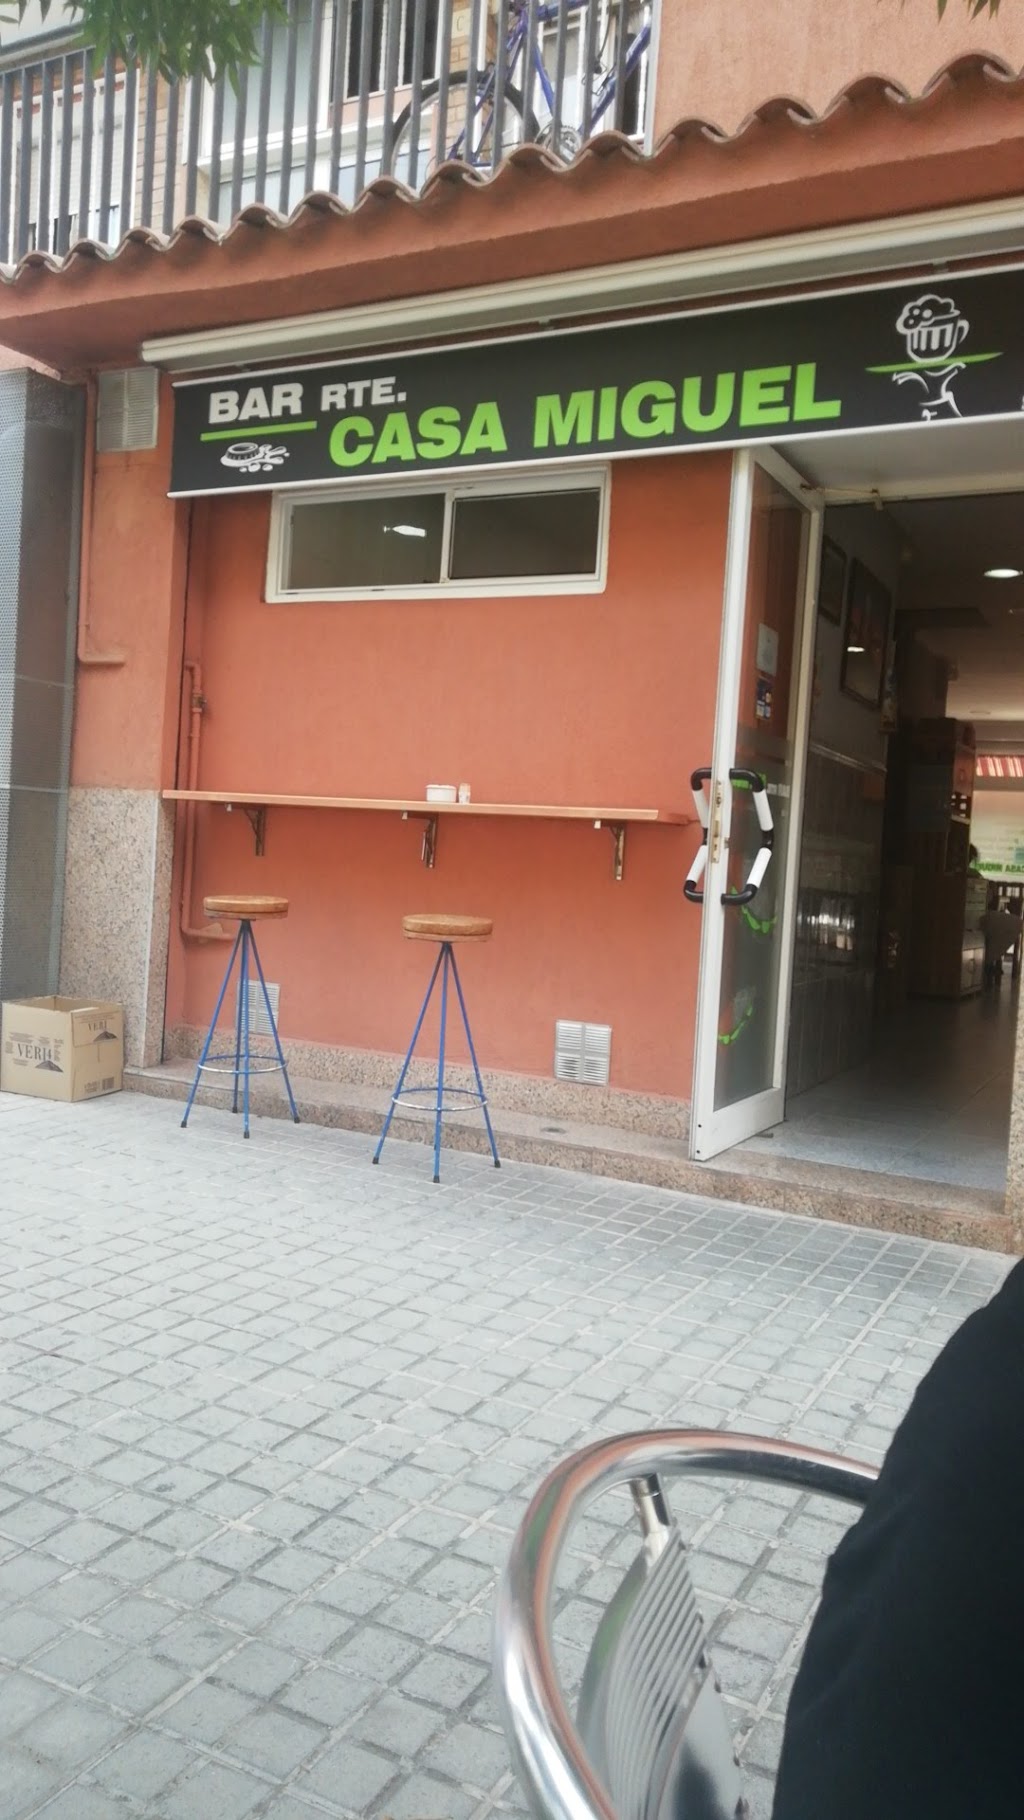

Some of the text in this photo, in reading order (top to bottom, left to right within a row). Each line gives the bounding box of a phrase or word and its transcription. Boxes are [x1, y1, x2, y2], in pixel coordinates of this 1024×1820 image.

[208, 376, 407, 424] BAR RTE.
[328, 362, 842, 468] CASA MIGUEL
